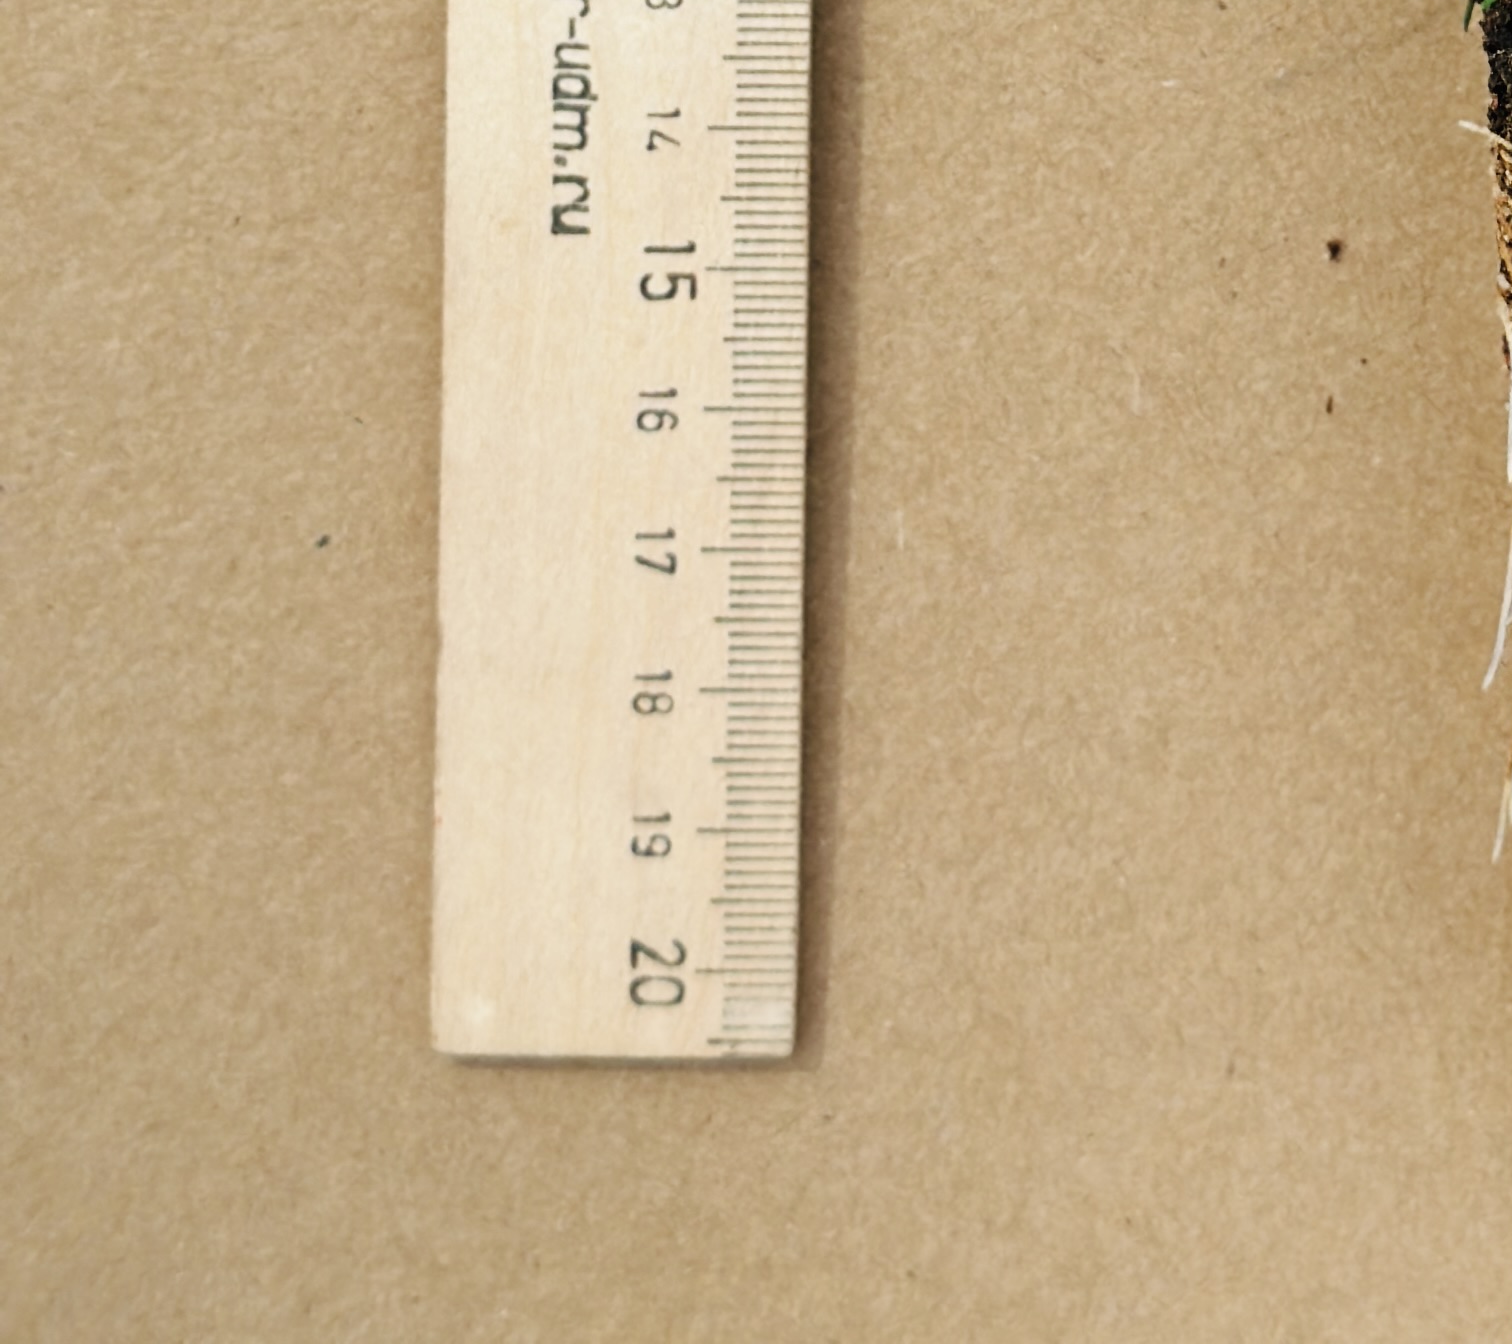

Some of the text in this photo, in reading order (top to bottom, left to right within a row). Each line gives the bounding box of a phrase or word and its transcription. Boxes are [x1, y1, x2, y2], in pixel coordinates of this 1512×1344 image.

[645, 107, 682, 152] 14
[638, 240, 699, 302] 15
[635, 387, 680, 433] 16
[634, 527, 678, 577] 17
[630, 669, 675, 716] 18
[629, 811, 673, 859] 19
[628, 938, 688, 1008] 20
